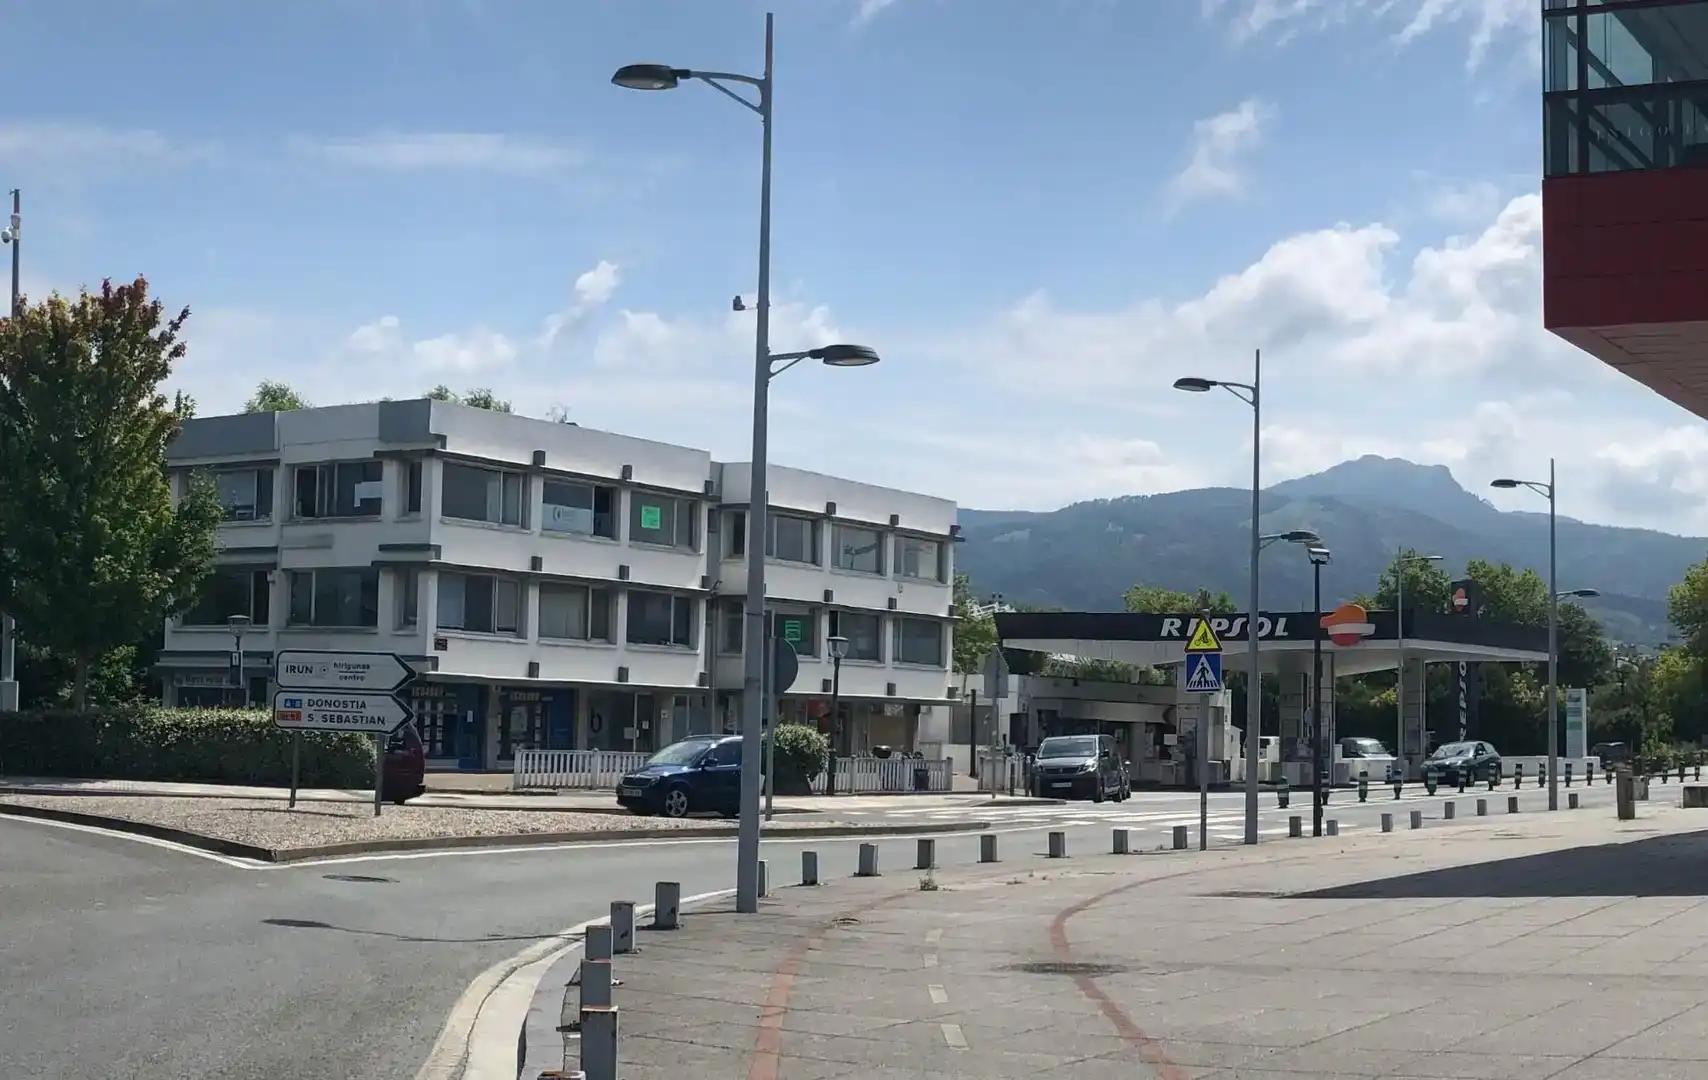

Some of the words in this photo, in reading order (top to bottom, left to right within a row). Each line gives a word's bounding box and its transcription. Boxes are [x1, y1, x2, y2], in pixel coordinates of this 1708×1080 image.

[285, 664, 314, 675] IRUN
[307, 698, 367, 710] DONOSTIA
[321, 714, 386, 726] SEBASTIAN
